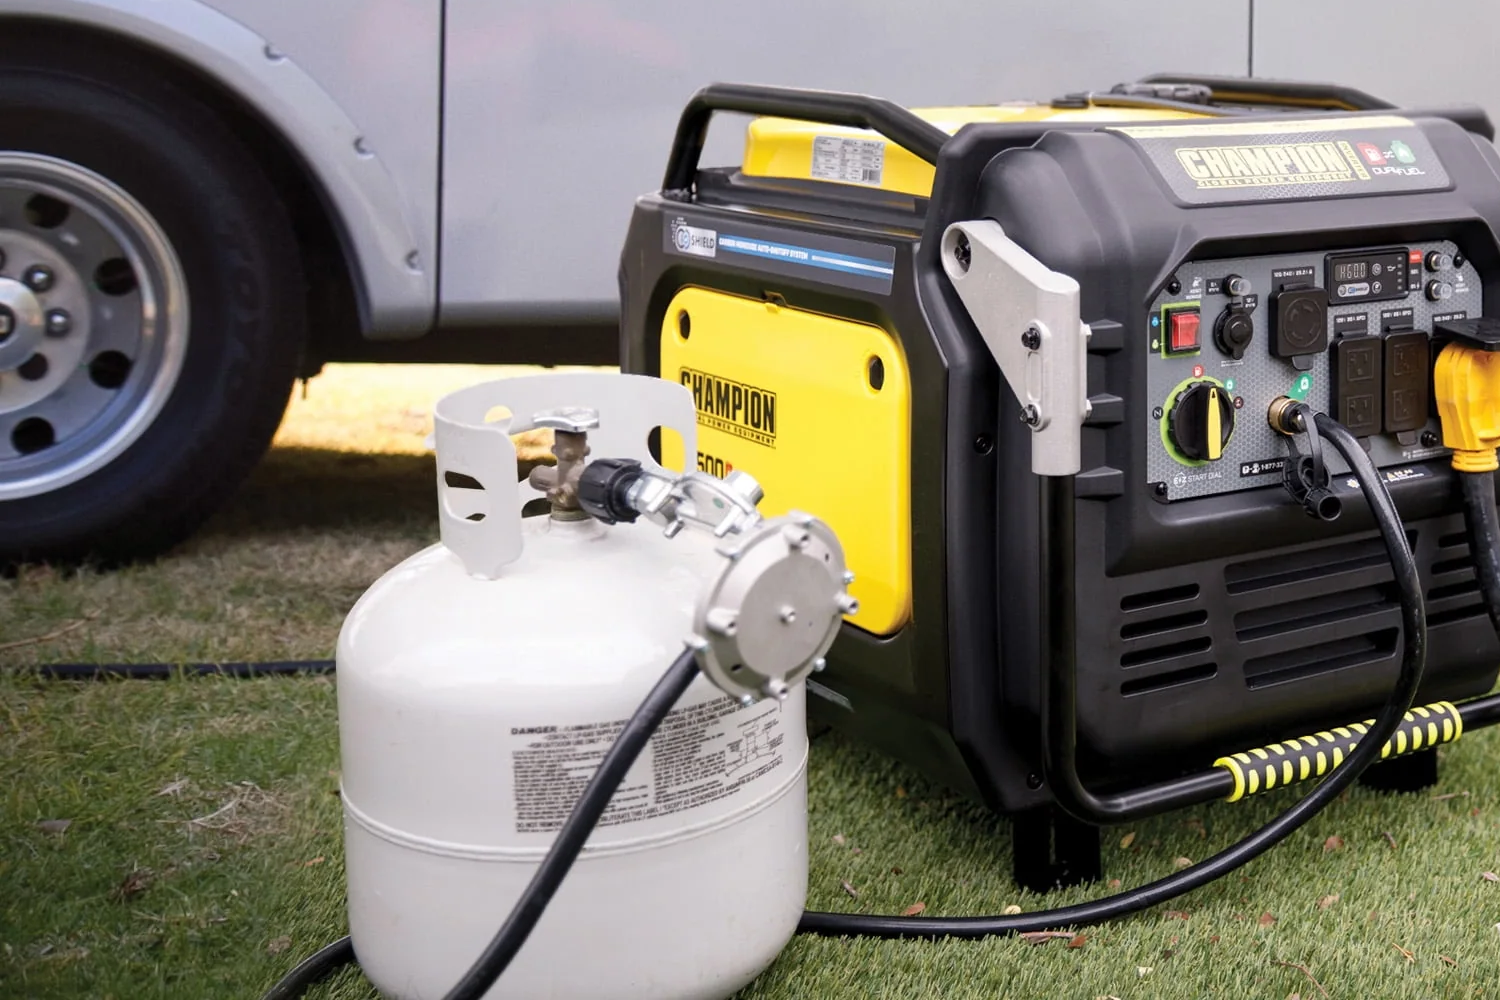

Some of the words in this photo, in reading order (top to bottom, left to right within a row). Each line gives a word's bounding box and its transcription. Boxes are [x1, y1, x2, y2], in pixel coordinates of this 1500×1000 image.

[1177, 142, 1354, 179] CHAMPION
[1198, 178, 1242, 187] GLOBAL
[1245, 175, 1285, 185] POWER
[1288, 172, 1352, 183] EQUIPMENT
[692, 235, 715, 249] SHIELD
[707, 418, 731, 430] POWER
[734, 426, 775, 446] EQUIPMENT
[1188, 473, 1207, 483] START
[1208, 471, 1222, 480] DIAL
[510, 725, 557, 735] DANGER
